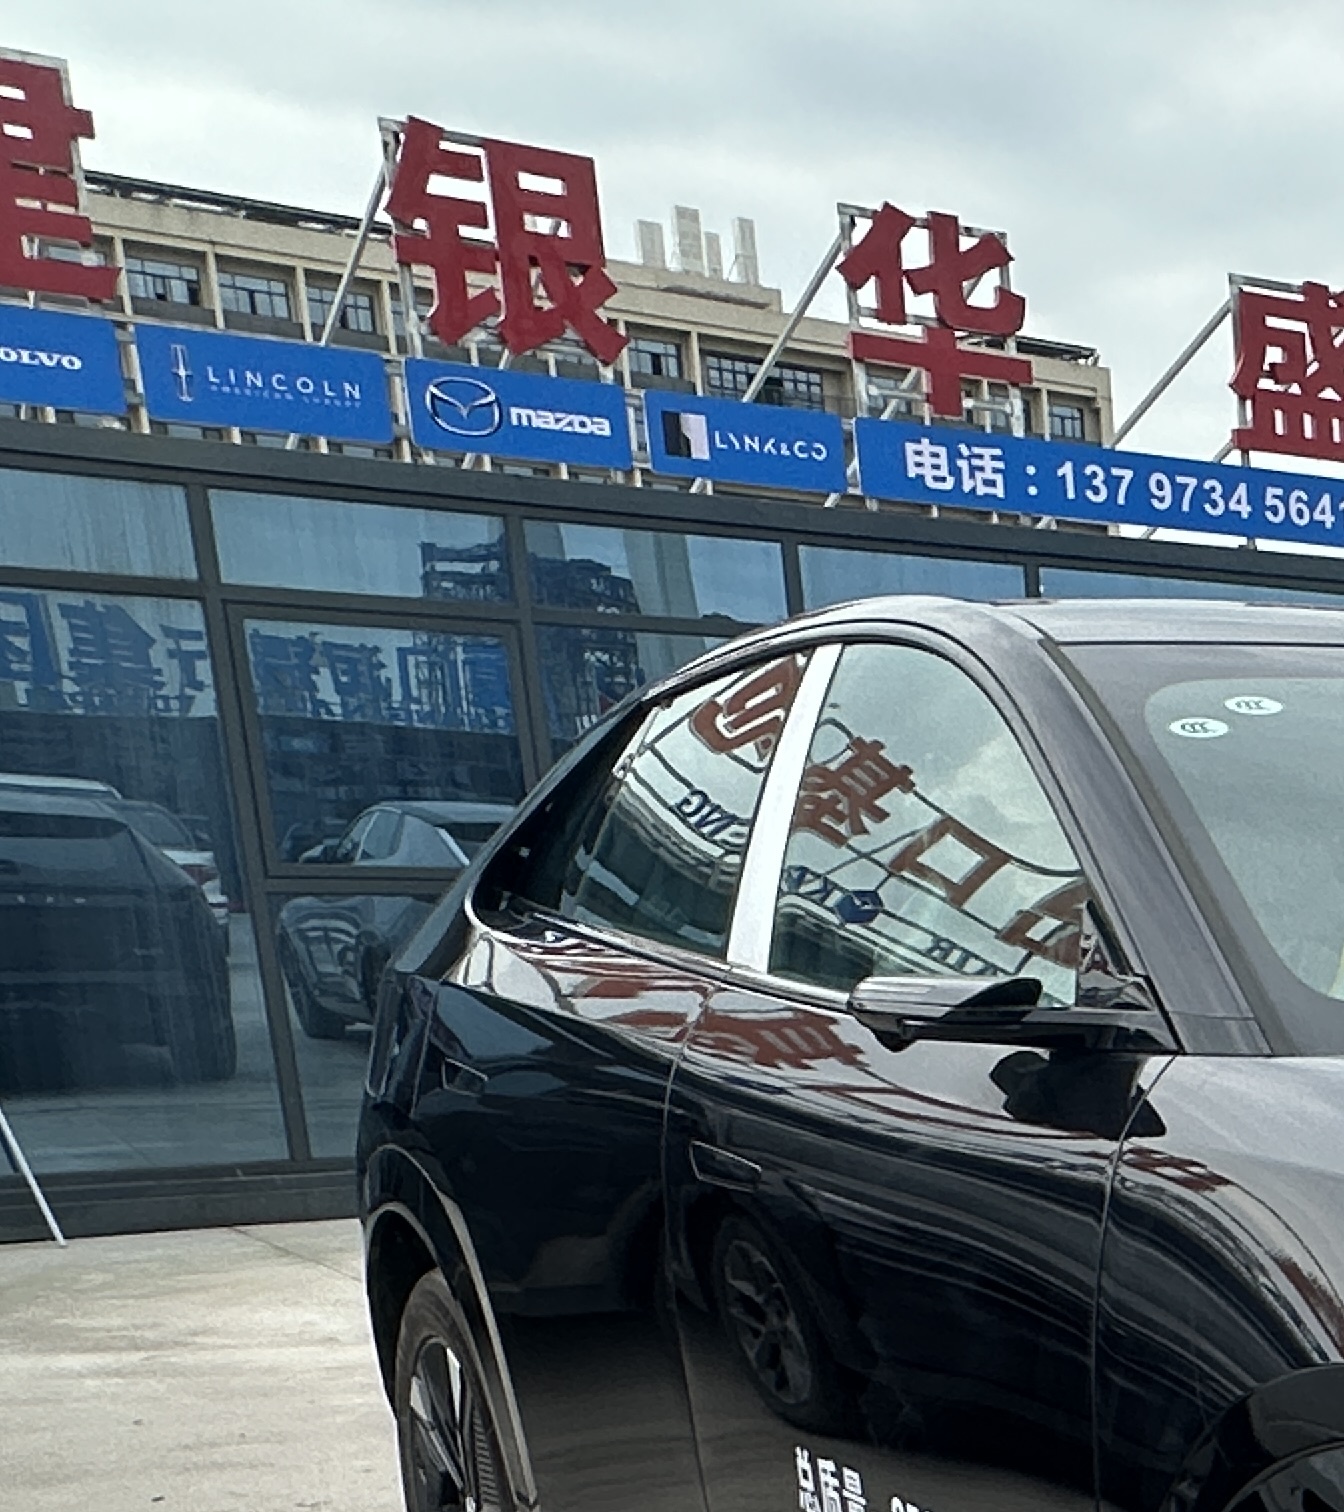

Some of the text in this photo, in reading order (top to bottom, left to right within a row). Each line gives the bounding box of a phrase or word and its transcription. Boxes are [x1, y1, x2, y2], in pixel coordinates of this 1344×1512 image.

[207, 366, 361, 399] LINCOLN
[1056, 460, 1135, 506] 137
[1150, 473, 1253, 521] 9734
